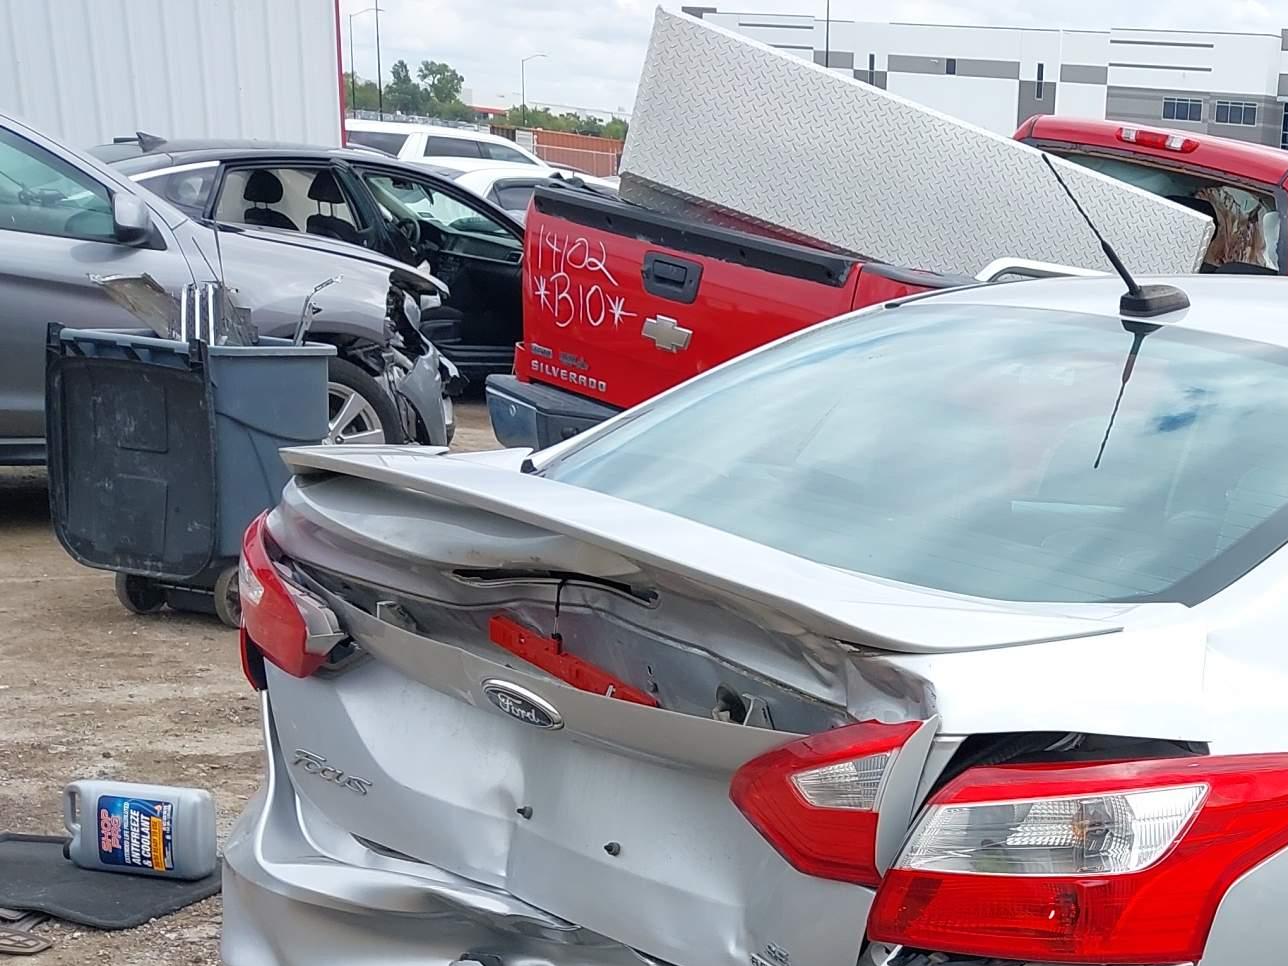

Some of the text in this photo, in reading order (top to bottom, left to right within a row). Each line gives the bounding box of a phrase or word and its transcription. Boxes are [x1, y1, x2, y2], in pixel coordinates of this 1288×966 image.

[531, 360, 607, 392] SILVERADO
[496, 692, 541, 724] Ford
[101, 808, 112, 853] SHOP
[130, 809, 142, 866] ANTIFREEZE
[140, 813, 152, 858] COOLANT
